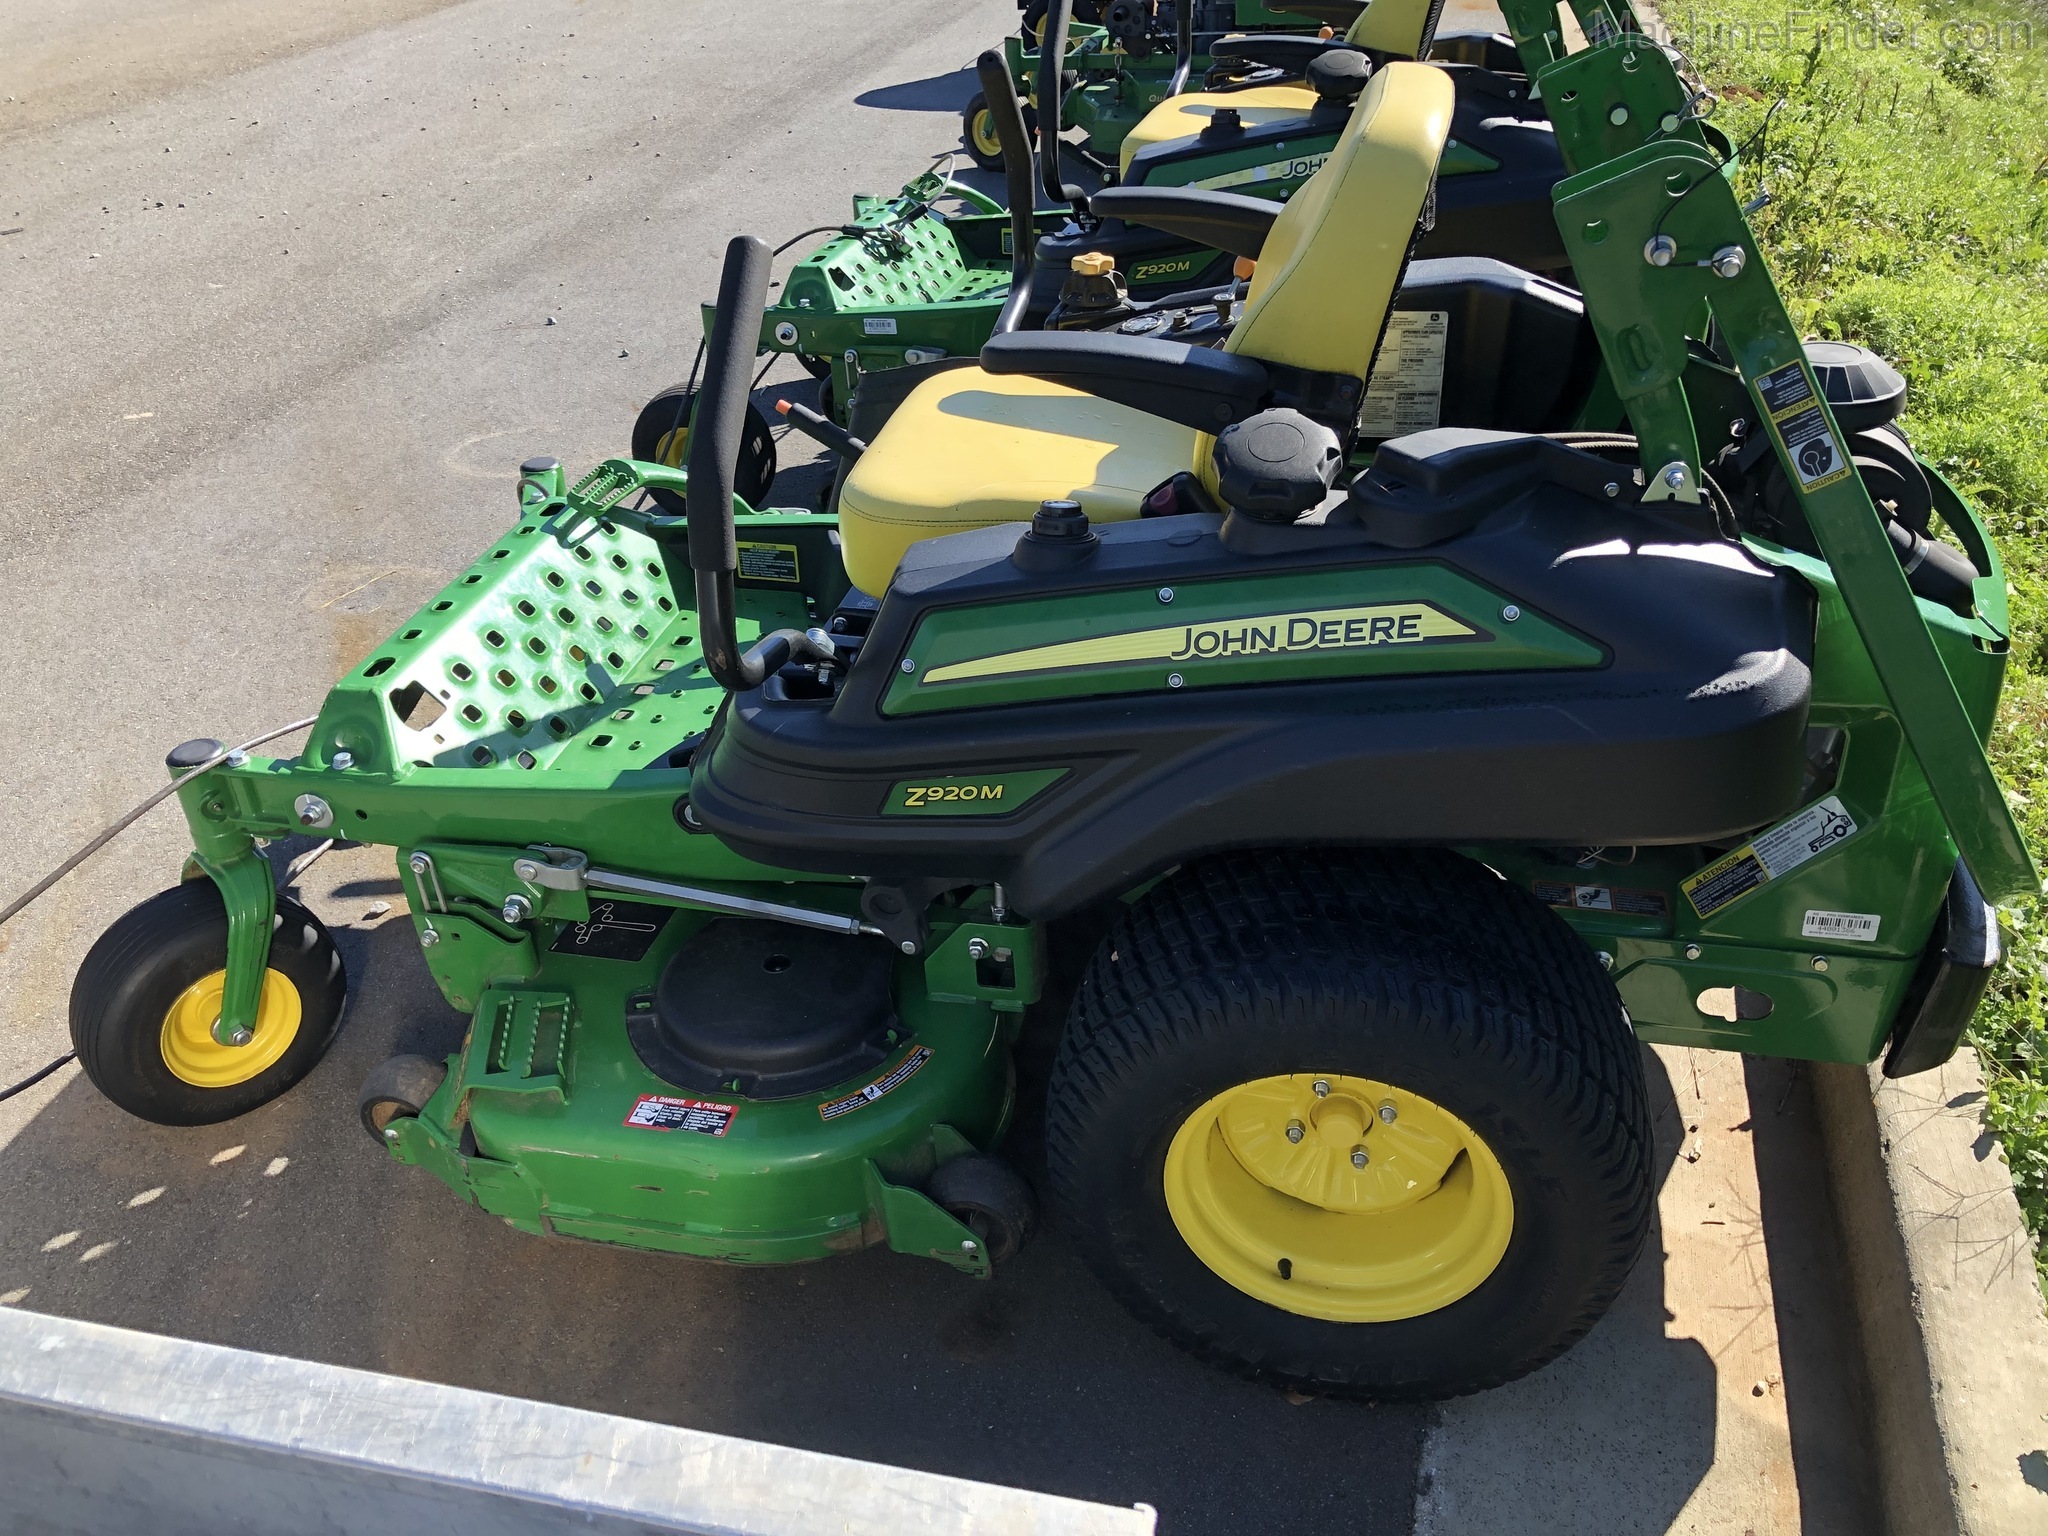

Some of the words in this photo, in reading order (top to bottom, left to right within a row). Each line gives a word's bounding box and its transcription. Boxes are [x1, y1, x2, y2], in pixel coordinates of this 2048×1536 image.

[1135, 260, 1190, 279] Z920M
[1807, 474, 1840, 491] CAUTION
[1171, 624, 1276, 659] JOHN
[1287, 614, 1422, 648] DEERE
[904, 783, 1004, 808] Z920M
[658, 1096, 686, 1105] DANGER
[702, 1102, 732, 1111] PELIGRO
